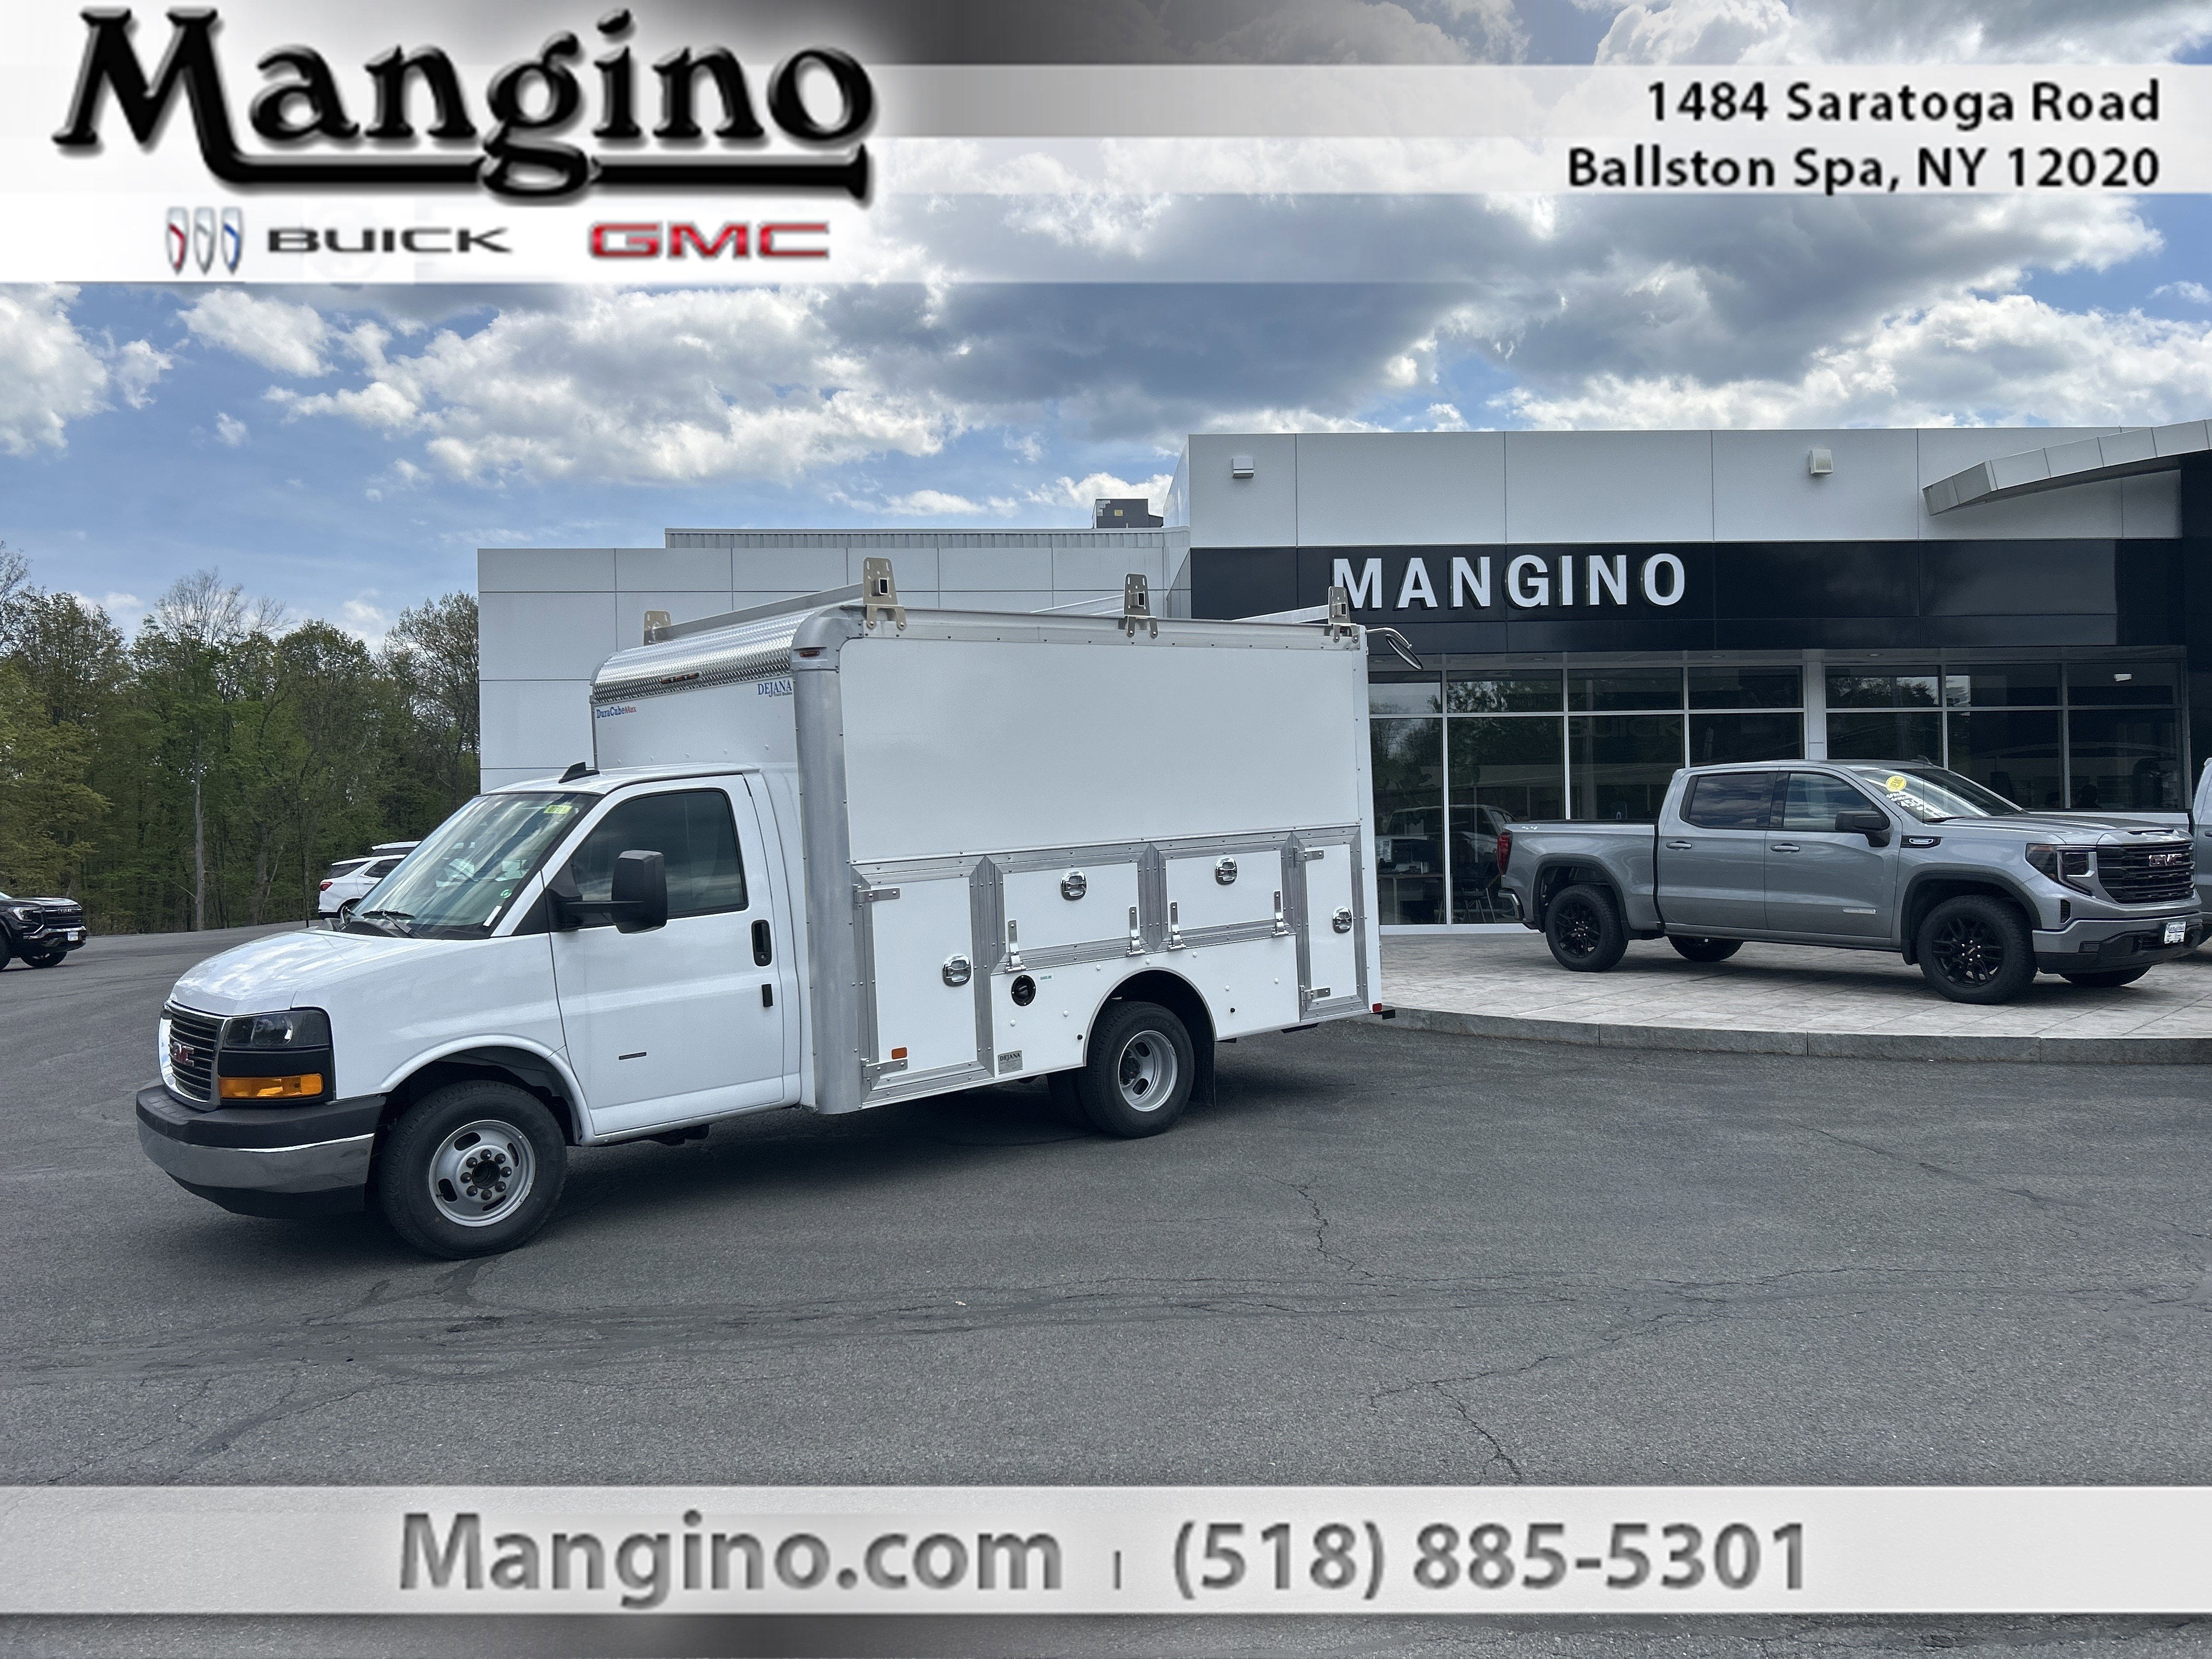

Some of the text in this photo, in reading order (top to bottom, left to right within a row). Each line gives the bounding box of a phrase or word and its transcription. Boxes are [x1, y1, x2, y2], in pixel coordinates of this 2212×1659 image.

[1331, 553, 1685, 610] MANGINO
[757, 680, 792, 697] DEJANA
[1889, 777, 1904, 790] DEMO
[2148, 853, 2182, 867] GMC
[1000, 1053, 1021, 1062] DEJANA
